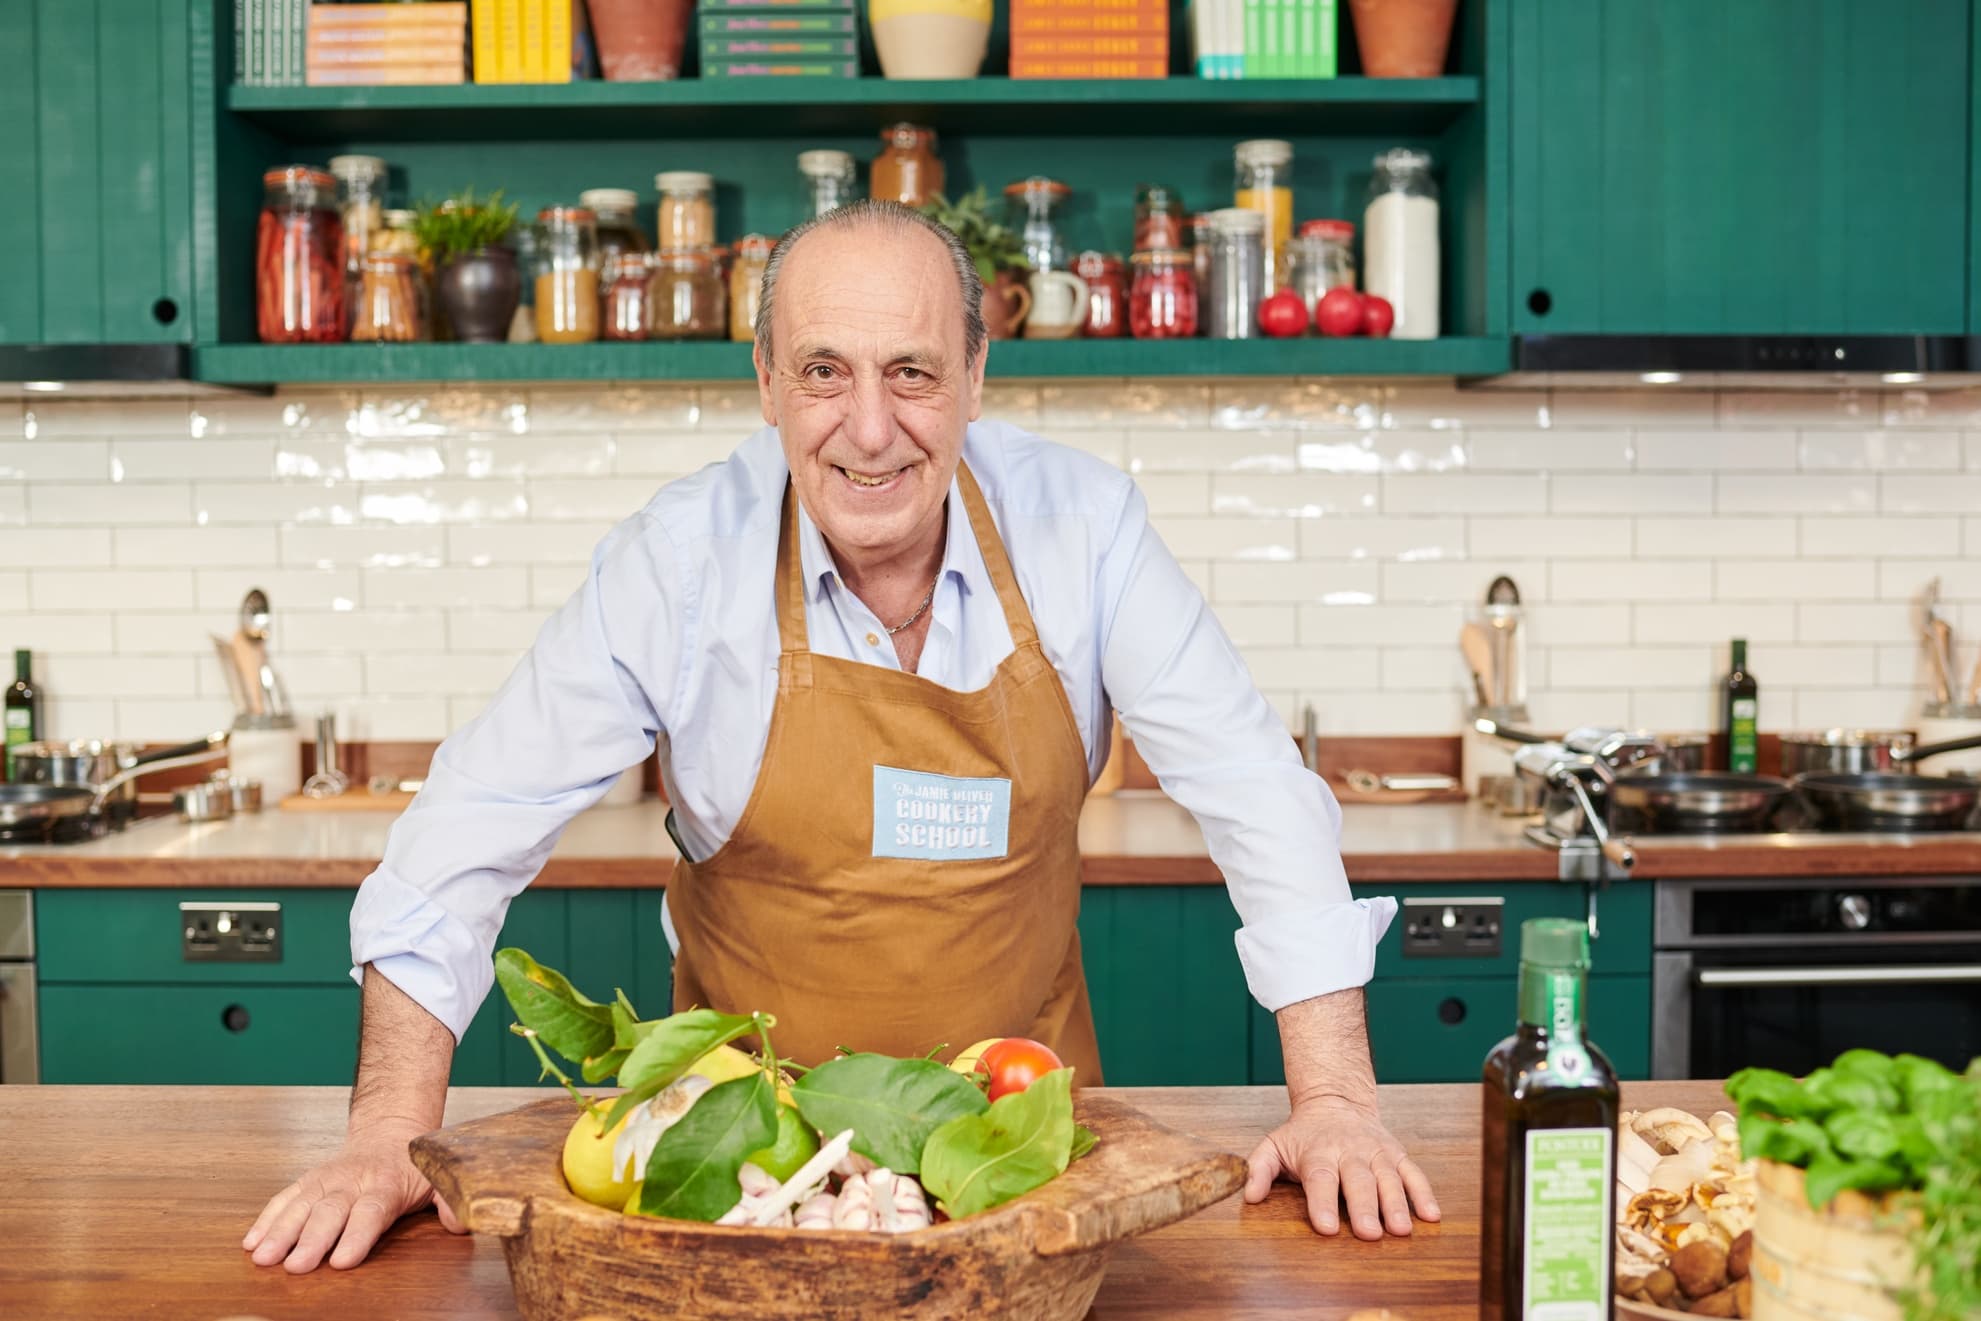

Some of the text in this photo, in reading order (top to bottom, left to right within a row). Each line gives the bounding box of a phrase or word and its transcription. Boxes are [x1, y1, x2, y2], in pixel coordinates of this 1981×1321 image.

[915, 784, 949, 800] JAMIE
[896, 798, 993, 824] COOKERY
[895, 822, 992, 849] SCHOOL
